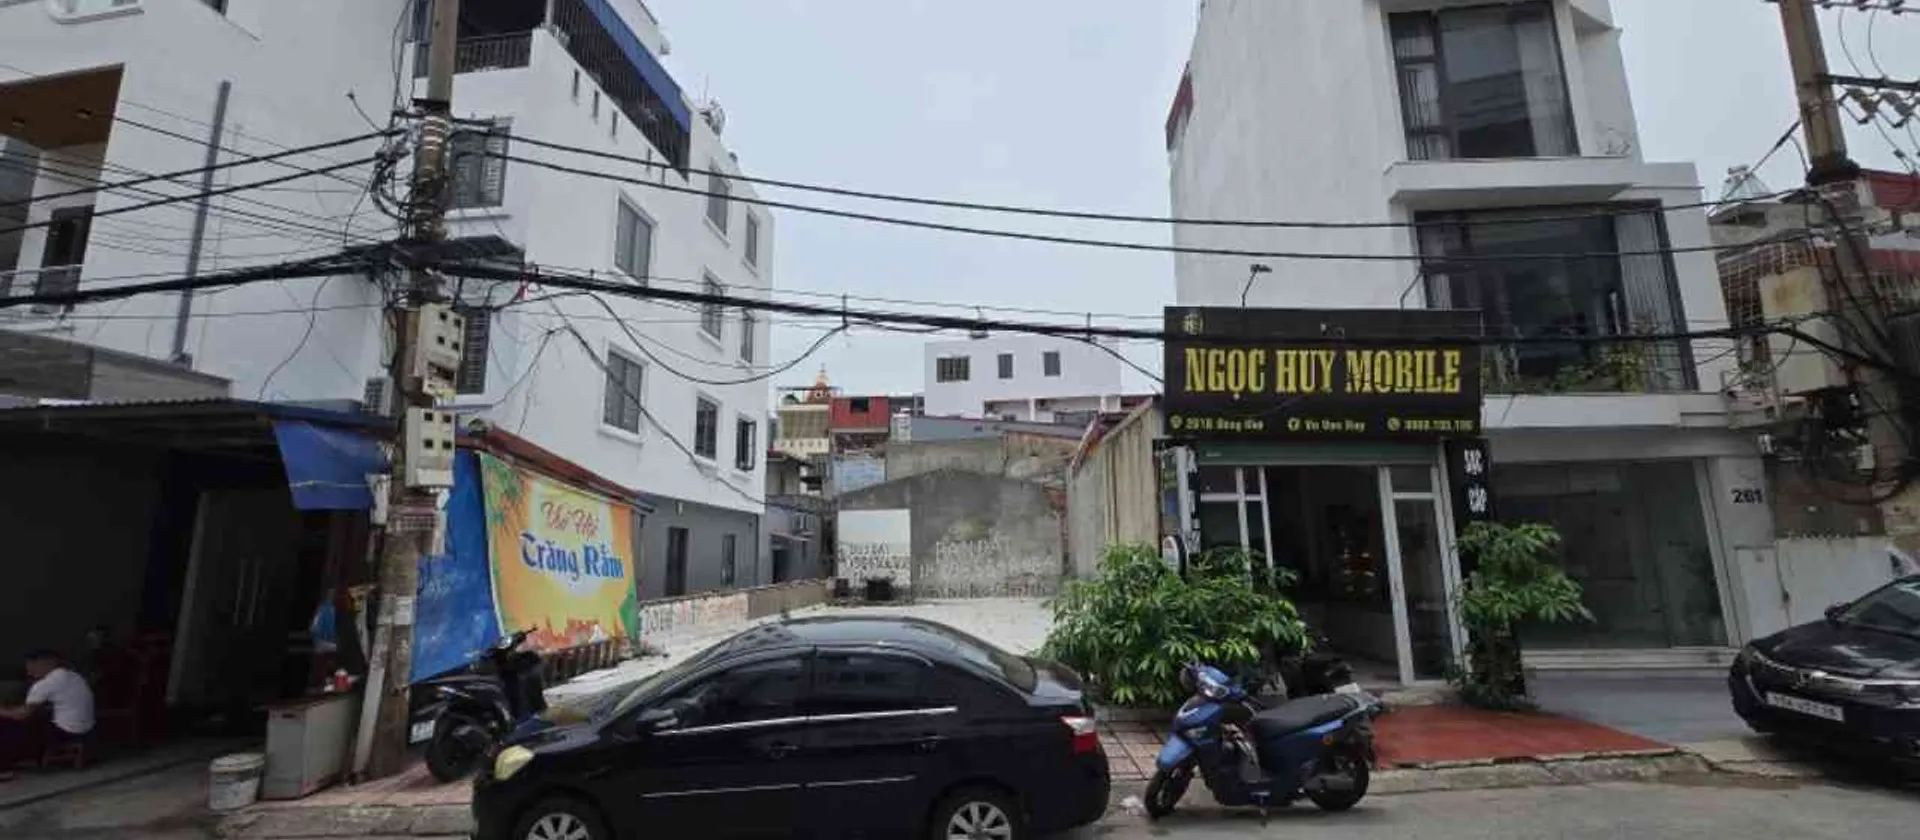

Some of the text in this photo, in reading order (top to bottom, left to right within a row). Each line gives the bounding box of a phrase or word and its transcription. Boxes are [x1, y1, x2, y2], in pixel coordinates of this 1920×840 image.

[1184, 347, 1461, 399] NGỌC HUY MOBILE
[519, 531, 625, 582] Trăng Rằm
